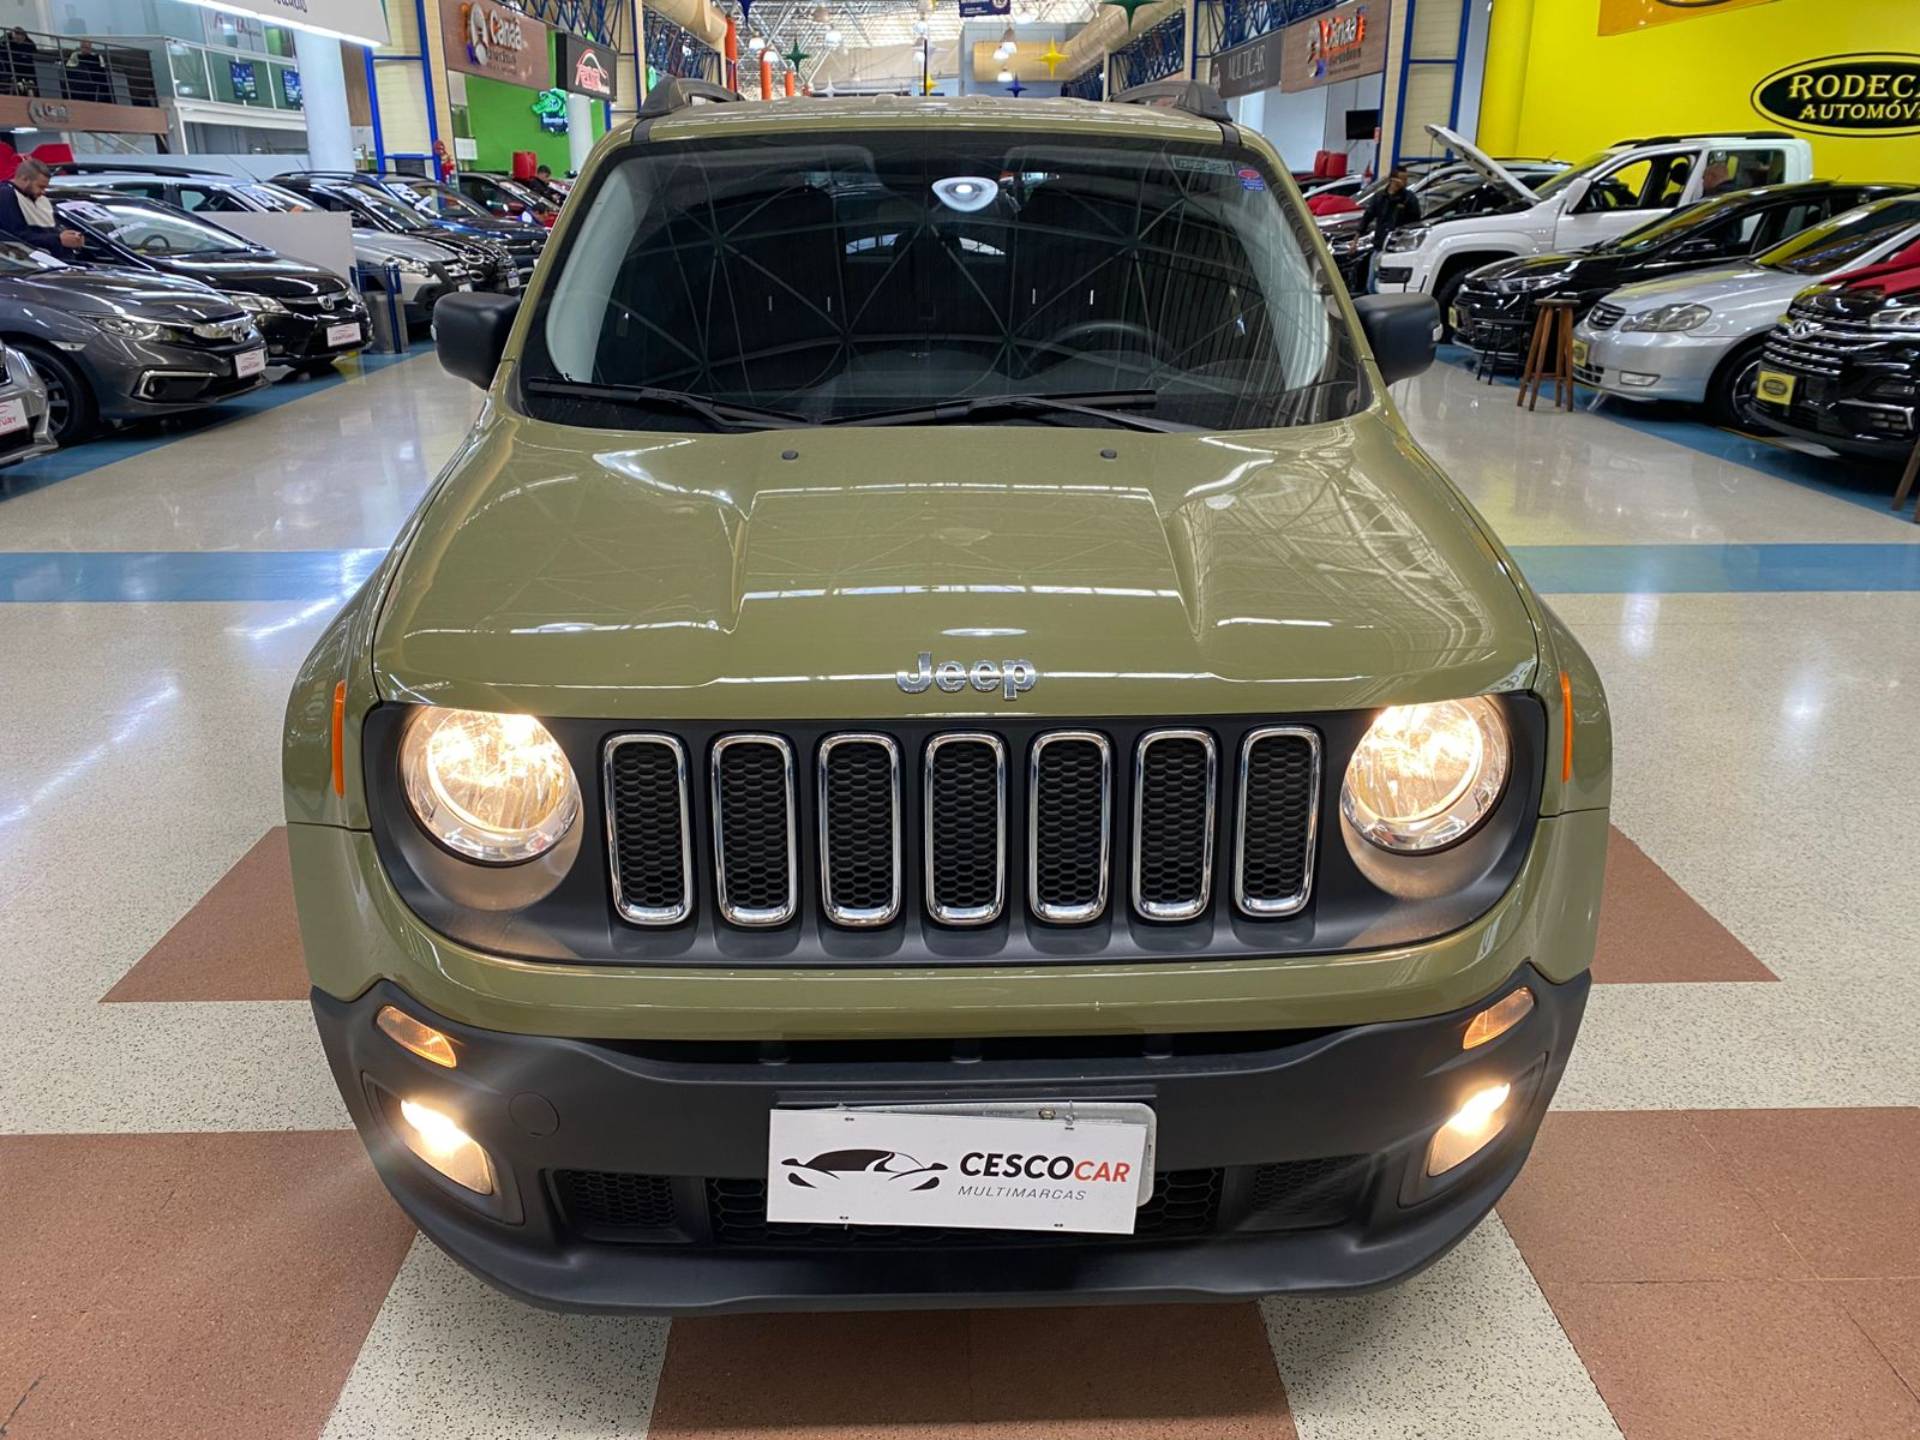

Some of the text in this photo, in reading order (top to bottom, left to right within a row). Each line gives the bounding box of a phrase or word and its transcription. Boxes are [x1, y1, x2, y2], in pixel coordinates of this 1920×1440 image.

[896, 651, 1037, 700] Jeep
[959, 1151, 1131, 1183] CESCOCAR
[957, 1185, 1087, 1201] MULTIMARCAS
